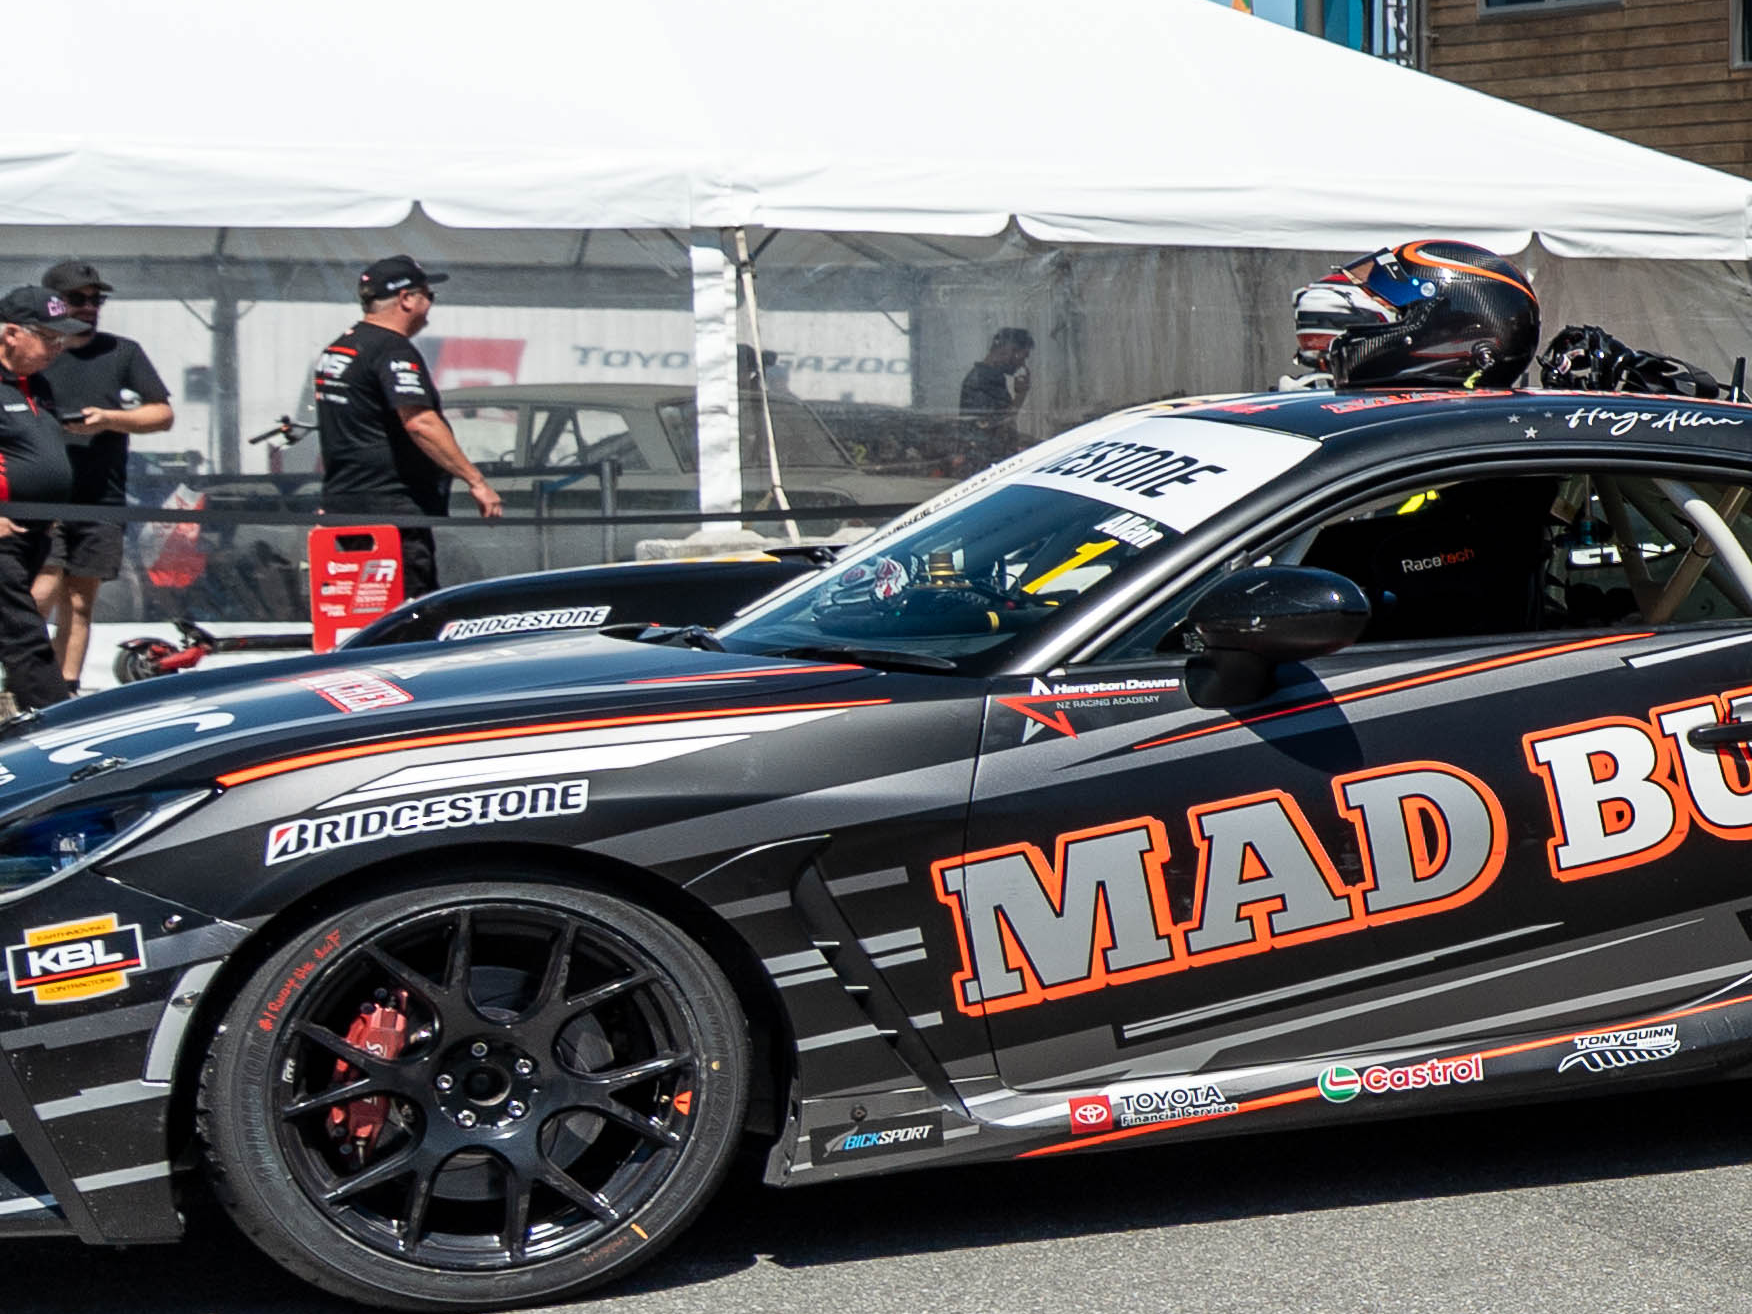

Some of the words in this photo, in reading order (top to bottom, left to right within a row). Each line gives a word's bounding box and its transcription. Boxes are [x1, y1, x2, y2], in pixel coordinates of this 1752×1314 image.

[572, 344, 692, 371] TOYO
[776, 350, 911, 376] GAZOO
[1565, 407, 1653, 436] Hugo
[1652, 408, 1745, 431] Allan
[1037, 438, 1228, 499] GESTONE
[1094, 513, 1164, 549] Allan
[1023, 538, 1119, 594] 1
[1401, 546, 1475, 575] Racetech
[443, 608, 609, 640] BRIDGESTONE
[1052, 676, 1124, 696] Hampton
[1125, 675, 1180, 692] Downs
[1056, 698, 1069, 710] NZ
[1071, 696, 1109, 709] RACING
[1111, 694, 1160, 708] ACADEMY
[270, 781, 588, 862] BRIDGESTONE
[931, 758, 1512, 1019] MAD
[27, 940, 124, 978] KBL
[44, 975, 116, 996] CONTRACTORS
[1576, 1032, 1624, 1051] TONY
[1625, 1024, 1677, 1047] QUINN
[1363, 1055, 1483, 1093] Castrol
[1120, 1083, 1225, 1116] TOYOTA
[1121, 1109, 1183, 1128] Financial
[1184, 1101, 1240, 1119] Services
[843, 1123, 934, 1151] BICKSPORT
